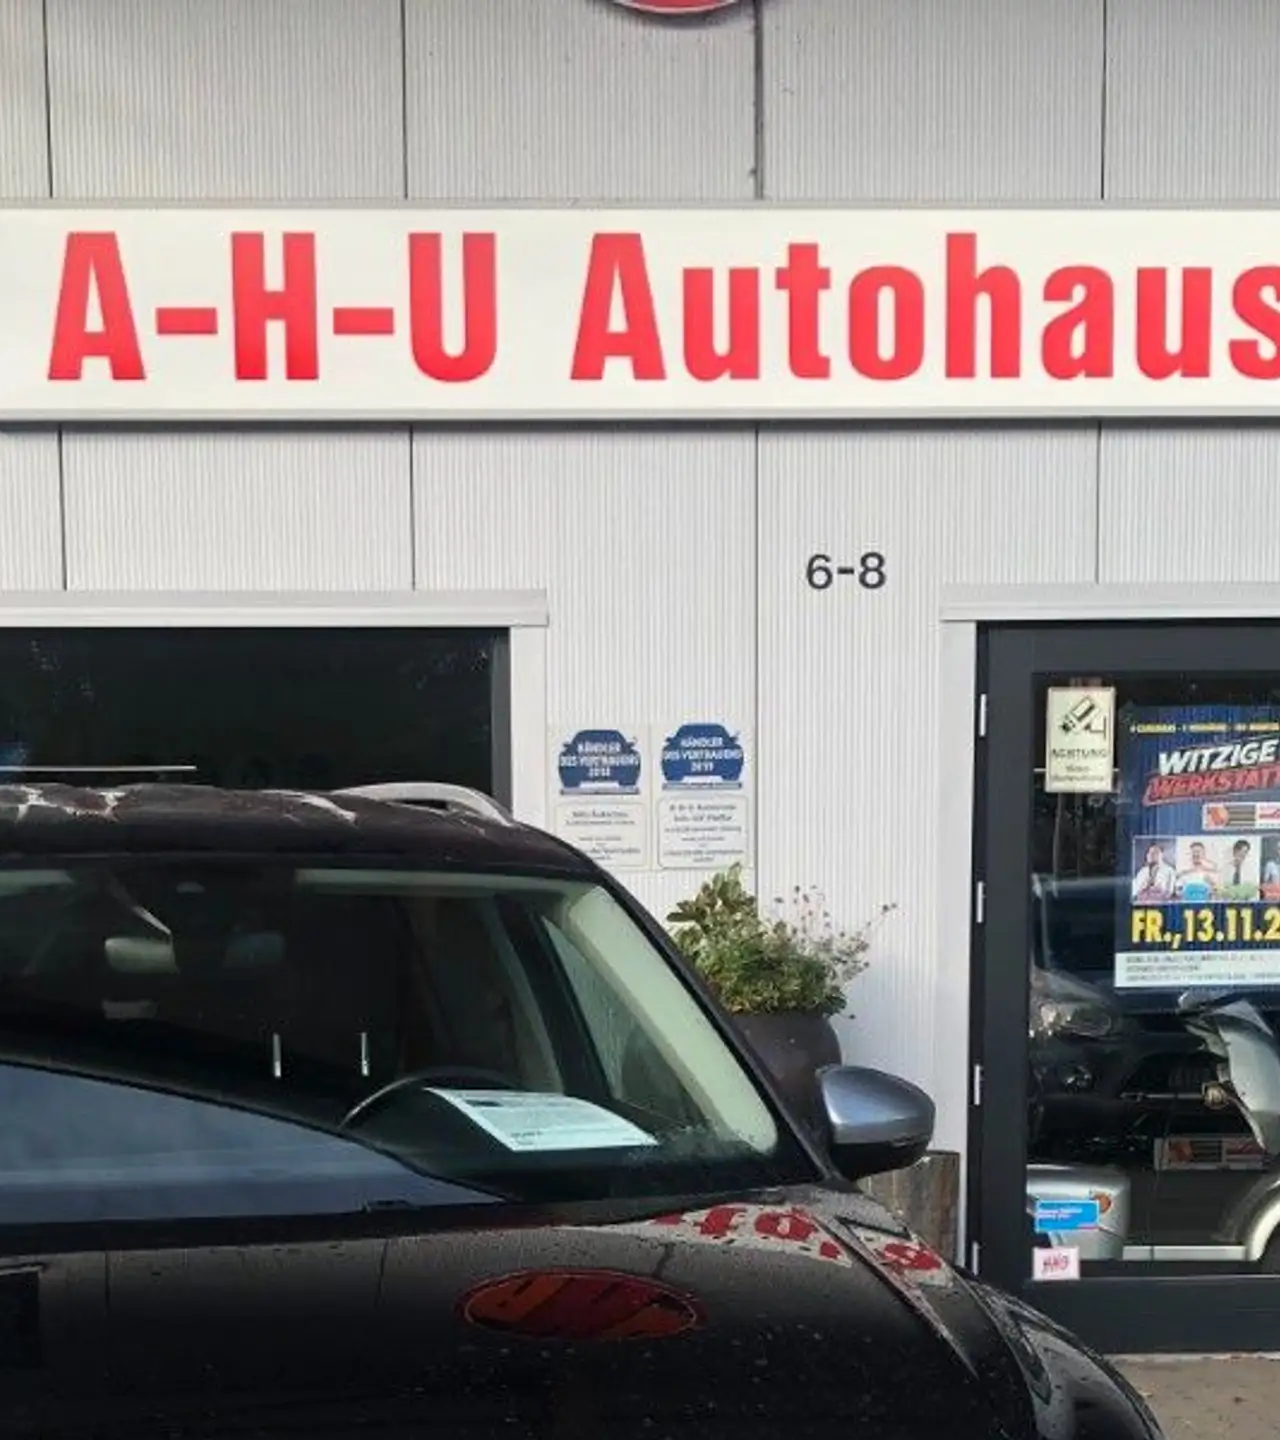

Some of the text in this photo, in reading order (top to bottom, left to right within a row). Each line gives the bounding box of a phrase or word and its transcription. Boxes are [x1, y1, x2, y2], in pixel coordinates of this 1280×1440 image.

[48, 231, 497, 383] A-H-U
[806, 551, 885, 589] 6-8
[1158, 738, 1280, 777] WITZIGE
